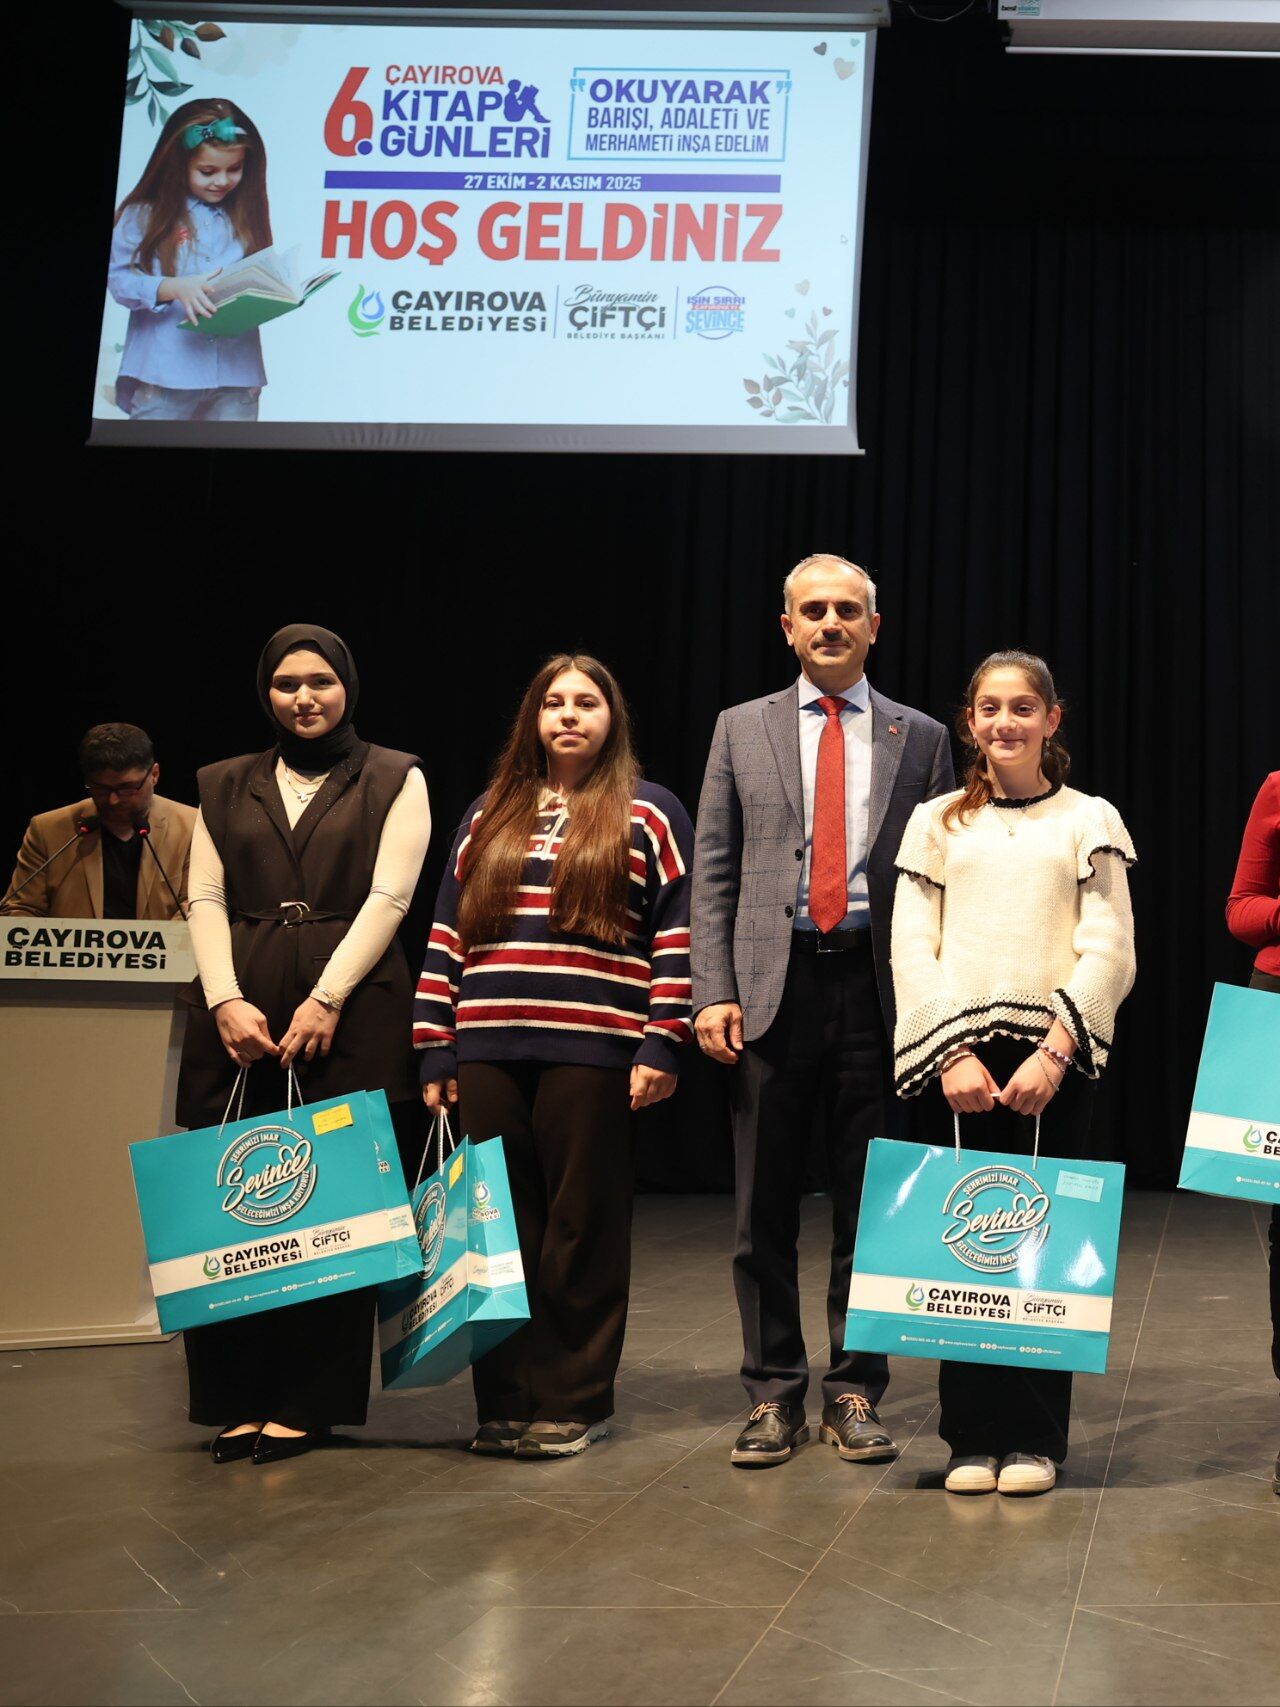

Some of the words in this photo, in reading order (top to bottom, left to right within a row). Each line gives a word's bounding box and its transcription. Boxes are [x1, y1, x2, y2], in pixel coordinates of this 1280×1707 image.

[385, 64, 505, 85] ÇAYIROVA
[589, 78, 771, 104] OKUYARAK
[587, 107, 654, 131] BARIŞI,
[747, 109, 770, 130] VE
[464, 175, 484, 189] 27
[550, 175, 602, 190] KASIM
[605, 176, 642, 190] 2025
[321, 199, 460, 266] HOŞ
[391, 290, 547, 313] ÇAYIROVA
[7, 926, 166, 950] ÇAYIROVA
[222, 1140, 312, 1212] Sevince
[941, 1193, 1050, 1244] Sevince
[222, 1238, 300, 1265] ÇAYIROVA
[928, 1288, 1011, 1307] ÇAYIROVA
